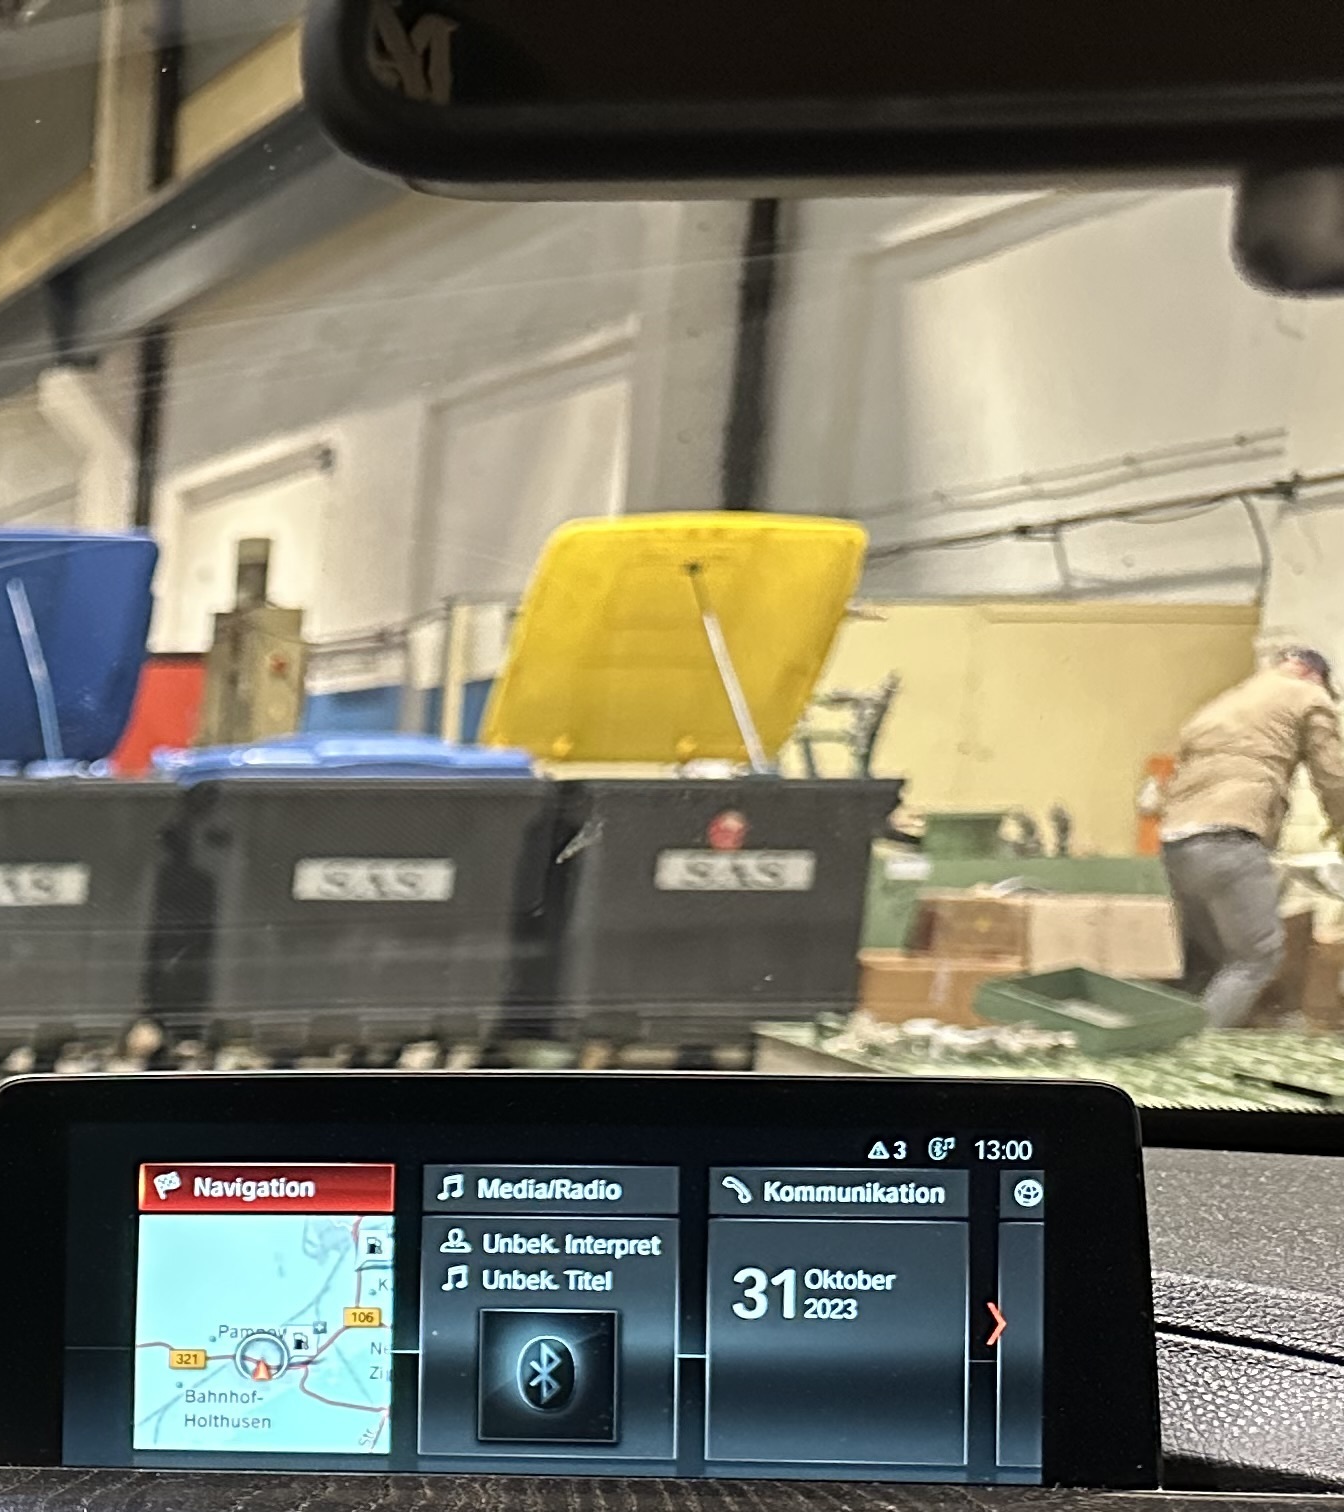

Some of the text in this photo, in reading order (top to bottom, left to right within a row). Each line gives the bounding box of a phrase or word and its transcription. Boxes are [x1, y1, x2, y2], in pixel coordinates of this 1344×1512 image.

[893, 1141, 907, 1159] 3
[974, 1140, 1033, 1161] 13:00
[193, 1176, 315, 1199] Navigation
[477, 1178, 623, 1201] Media/Radio
[763, 1181, 946, 1205] Kommunikation
[483, 1234, 662, 1259] Unbek. Interpret
[482, 1270, 613, 1292] Unbek. Titel
[732, 1267, 896, 1319] 31 Oktober
[351, 1311, 374, 1323] 106
[803, 1300, 858, 1320] 2023
[176, 1353, 198, 1365] 321
[185, 1389, 264, 1404] Bahnhof-
[184, 1413, 272, 1429] Holthusen
